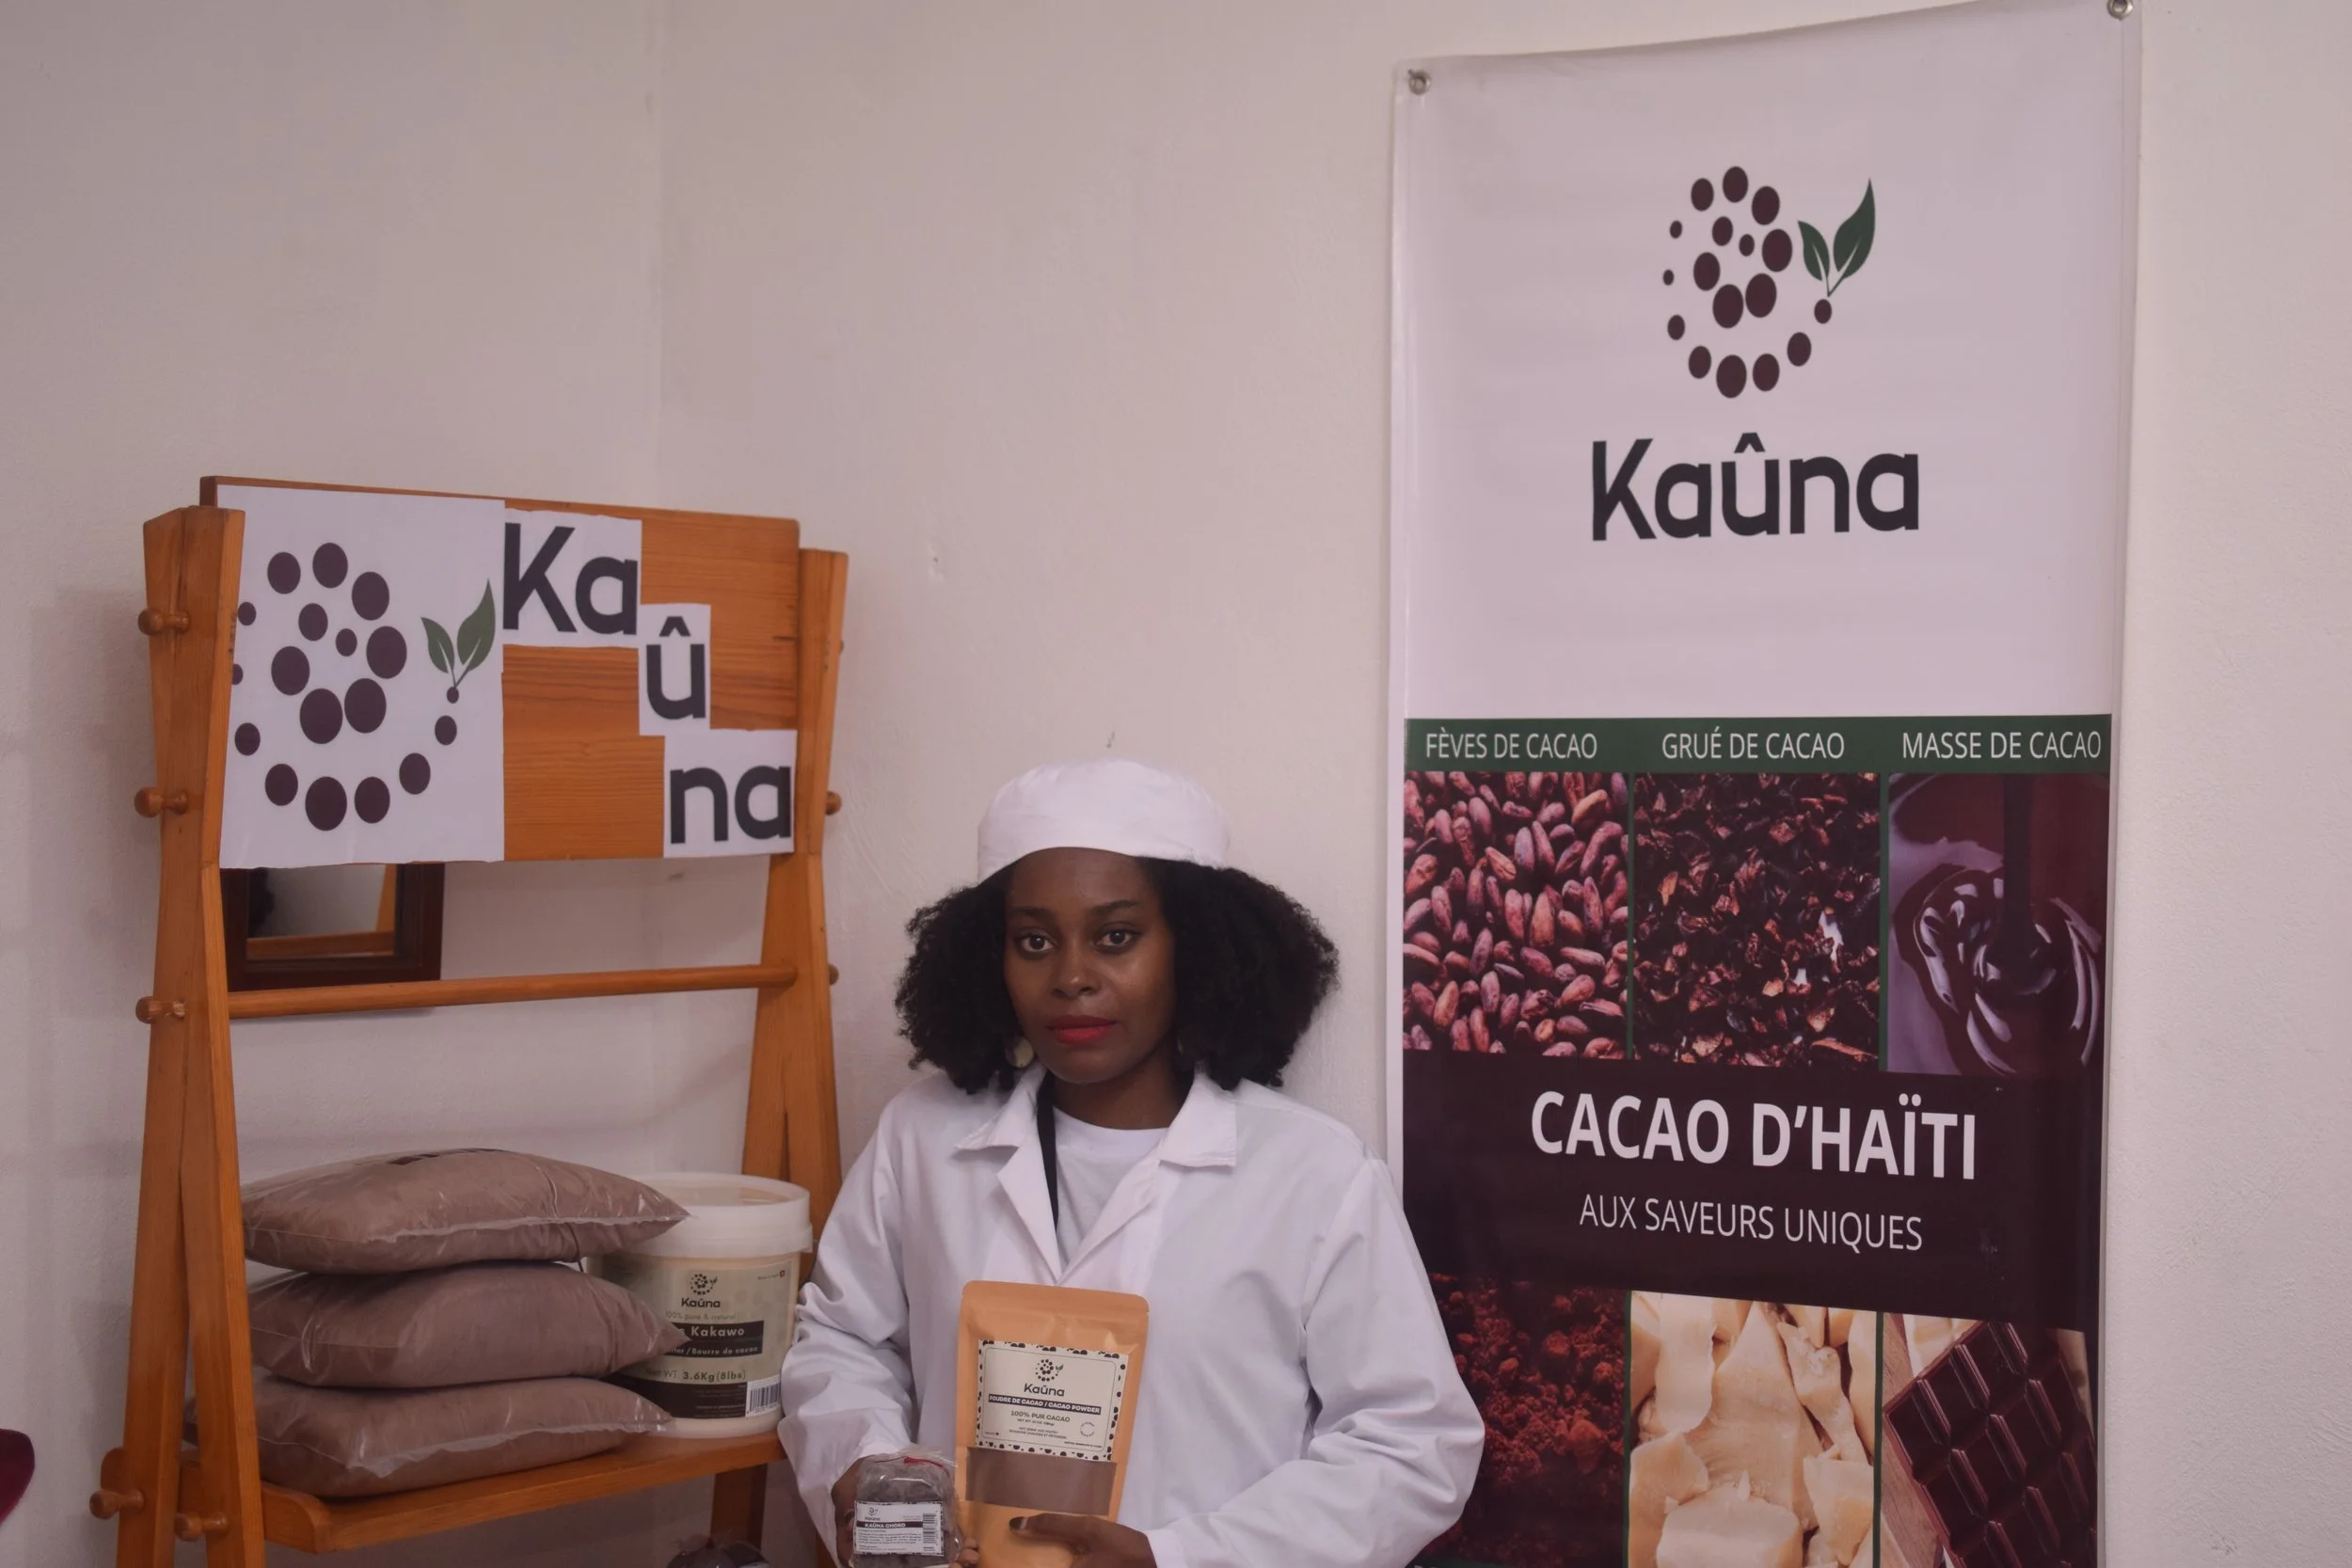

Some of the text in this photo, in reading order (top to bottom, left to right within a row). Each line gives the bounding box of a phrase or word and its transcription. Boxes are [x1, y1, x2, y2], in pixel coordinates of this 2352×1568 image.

[1593, 432, 1919, 542] Kaûna
[502, 522, 638, 635] Ka
[1425, 727, 1597, 760] FÈVES DE CACAO
[1661, 726, 1846, 760] GRUÉ DE CACAO
[1902, 731, 2102, 759] MASSE DE CACAO
[670, 765, 792, 845] na
[1531, 1090, 1730, 1164] CACAO
[1579, 1193, 1923, 1254] AUX SAVEURS UNIQUES
[691, 1325, 745, 1337] Kakawo
[989, 1395, 1011, 1403] POUDRE
[1021, 1399, 1043, 1407] CACAO
[1048, 1402, 1071, 1410] CACAO
[1072, 1404, 1100, 1414] POWDER
[1024, 1383, 1065, 1397] Kaûna
